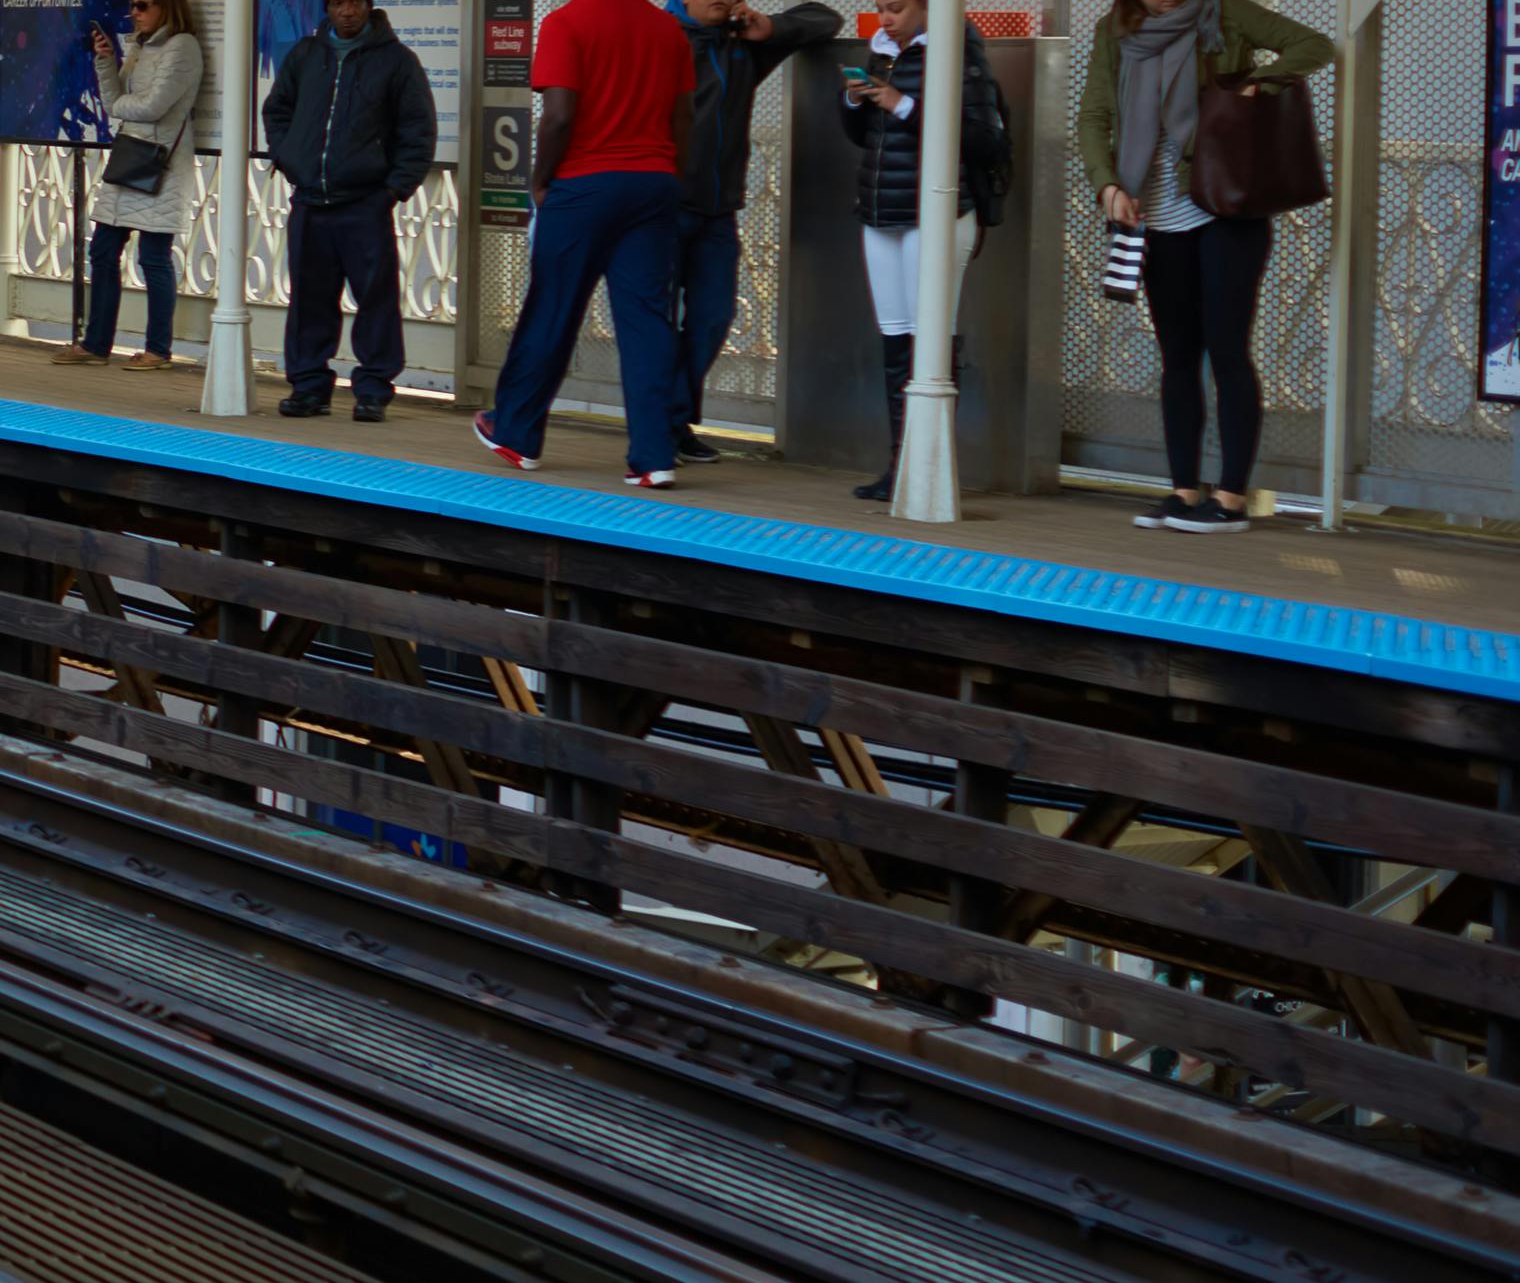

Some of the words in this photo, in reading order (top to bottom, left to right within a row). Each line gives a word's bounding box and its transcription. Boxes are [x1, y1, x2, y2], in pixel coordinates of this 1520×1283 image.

[492, 26, 508, 38] Red
[508, 25, 524, 38] Line
[493, 115, 519, 171] S
